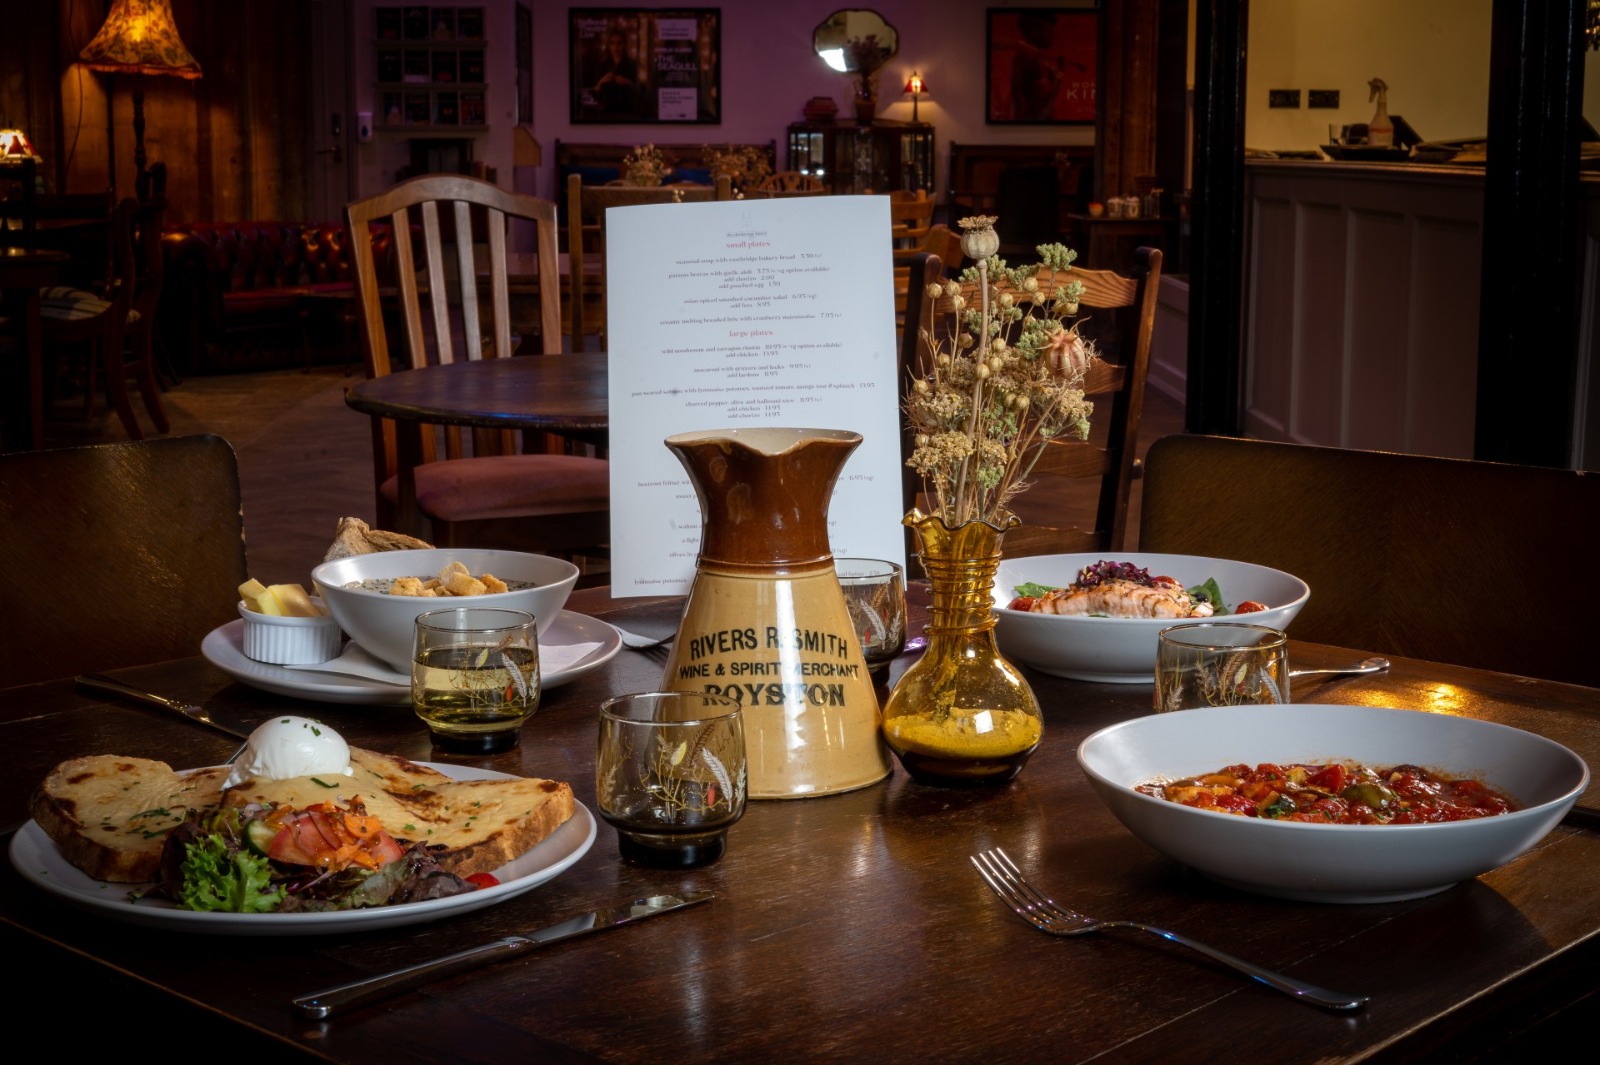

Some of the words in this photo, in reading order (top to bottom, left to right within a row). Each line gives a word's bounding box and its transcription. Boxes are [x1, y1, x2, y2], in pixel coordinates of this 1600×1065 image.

[658, 54, 674, 63] THE
[657, 62, 698, 71] SEAGULL
[726, 240, 747, 249] small
[748, 240, 771, 250] plates
[723, 269, 739, 277] garlic
[730, 282, 754, 290] poached
[729, 330, 749, 338] large
[750, 329, 774, 338] plates
[690, 628, 759, 661] RIVERS
[794, 629, 848, 660] SMITH
[680, 664, 711, 679] WINE
[715, 665, 727, 677] &
[731, 662, 782, 677] SPIRIT
[703, 683, 846, 707] ROYSTON
